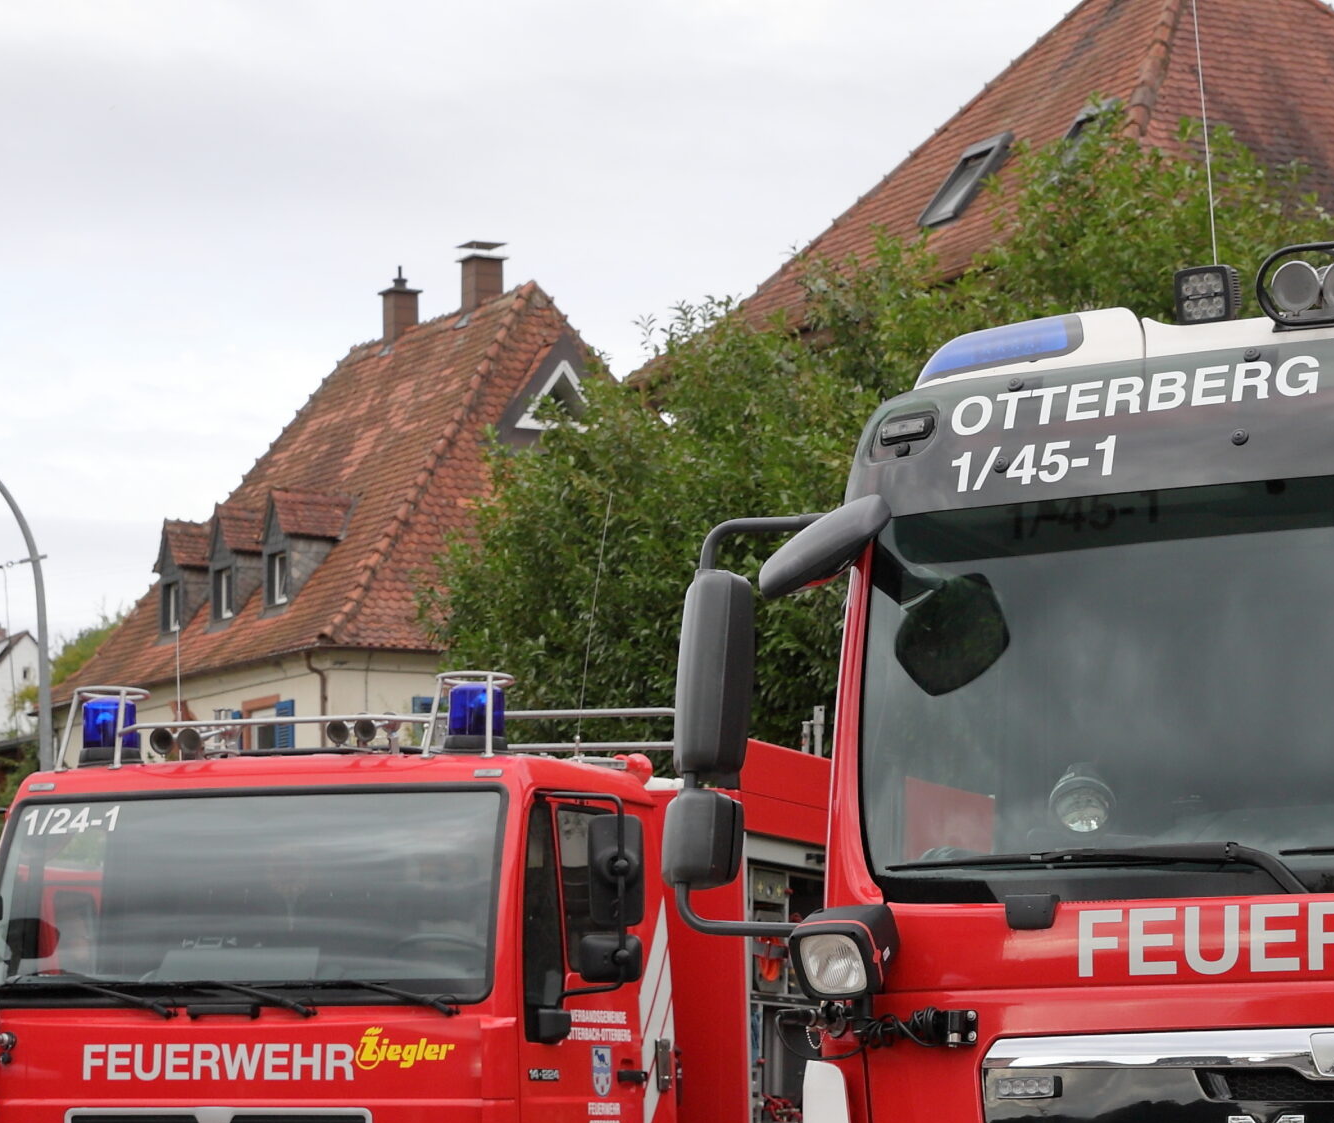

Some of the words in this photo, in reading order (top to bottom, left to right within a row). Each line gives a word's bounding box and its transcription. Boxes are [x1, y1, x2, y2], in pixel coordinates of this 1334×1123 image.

[950, 355, 1320, 437] OTTERBERG
[950, 435, 1117, 494] 1/45-1
[25, 805, 121, 836] 1/24-1
[82, 1043, 355, 1081] FEUERWEHR
[356, 1027, 456, 1070] Ziegler
